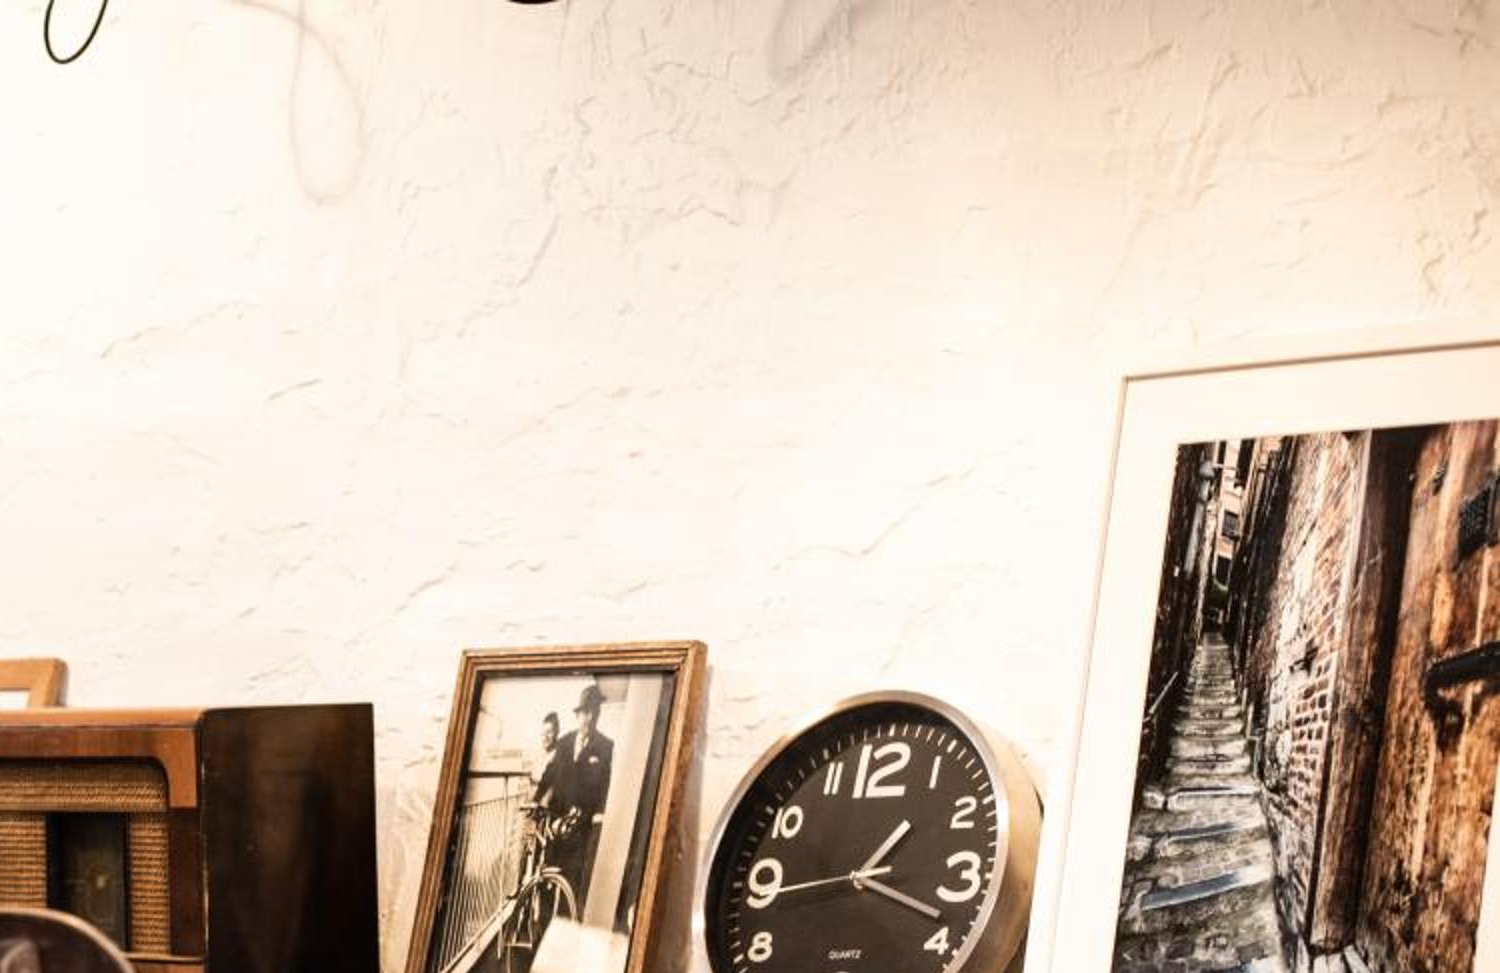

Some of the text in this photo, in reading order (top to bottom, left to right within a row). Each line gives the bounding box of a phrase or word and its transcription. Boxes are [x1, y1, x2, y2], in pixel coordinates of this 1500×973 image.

[822, 761, 844, 796] 11
[852, 741, 911, 799] 12
[929, 755, 942, 789] 1
[771, 804, 804, 840] 10
[949, 795, 978, 830] 2
[746, 857, 784, 909] 9
[935, 850, 982, 903] 3
[747, 931, 773, 962] 8
[828, 949, 862, 960] QUARTZ
[923, 926, 950, 955] 4
